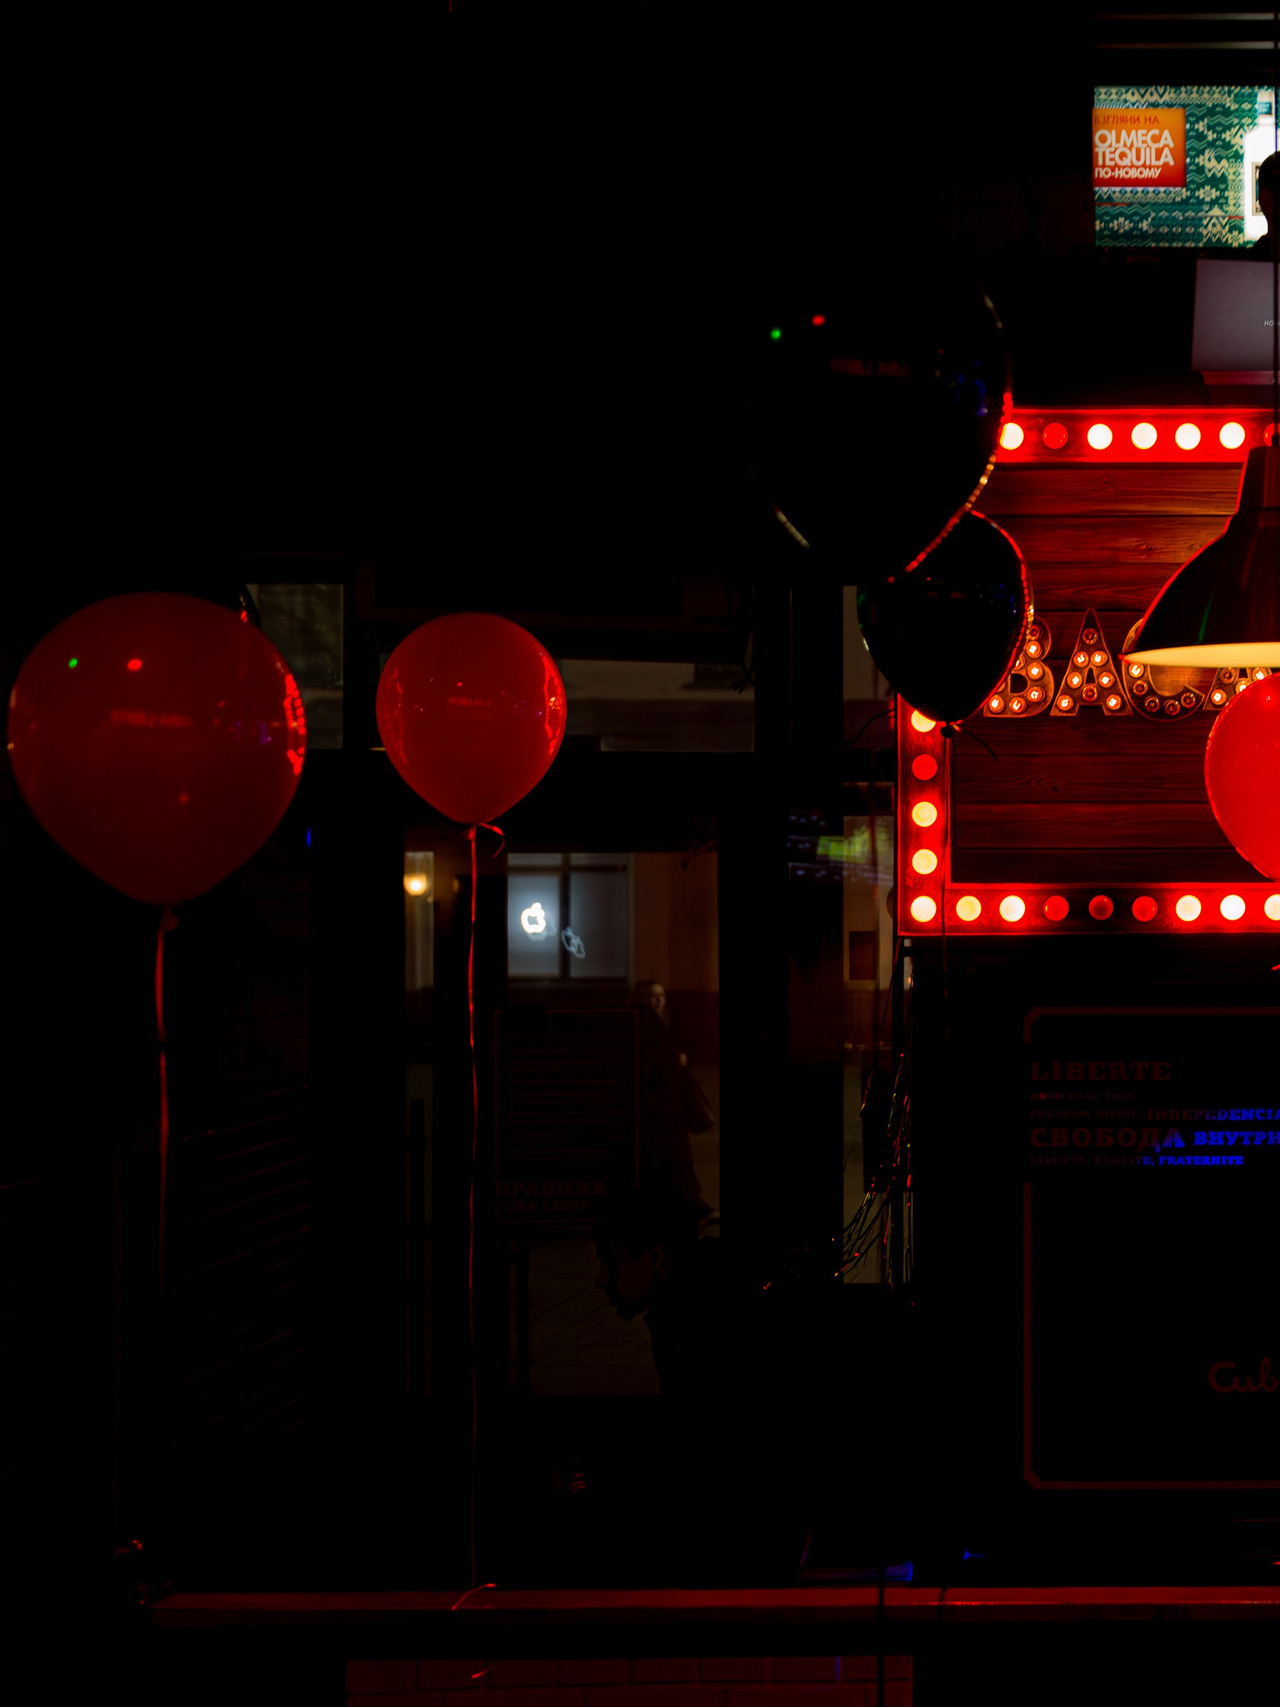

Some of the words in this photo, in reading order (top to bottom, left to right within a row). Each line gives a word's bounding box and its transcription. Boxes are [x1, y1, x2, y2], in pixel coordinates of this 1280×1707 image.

[1144, 115, 1160, 124] НА
[1094, 129, 1175, 148] OLMECA
[1094, 147, 1175, 167] TEQUILA
[1094, 167, 1162, 179] ПО-НОВОМУ
[1029, 1061, 1171, 1081] LIBERTE
[1029, 1126, 1186, 1152] СВОБОДА
[495, 1181, 606, 1198] ПРАВИЛА
